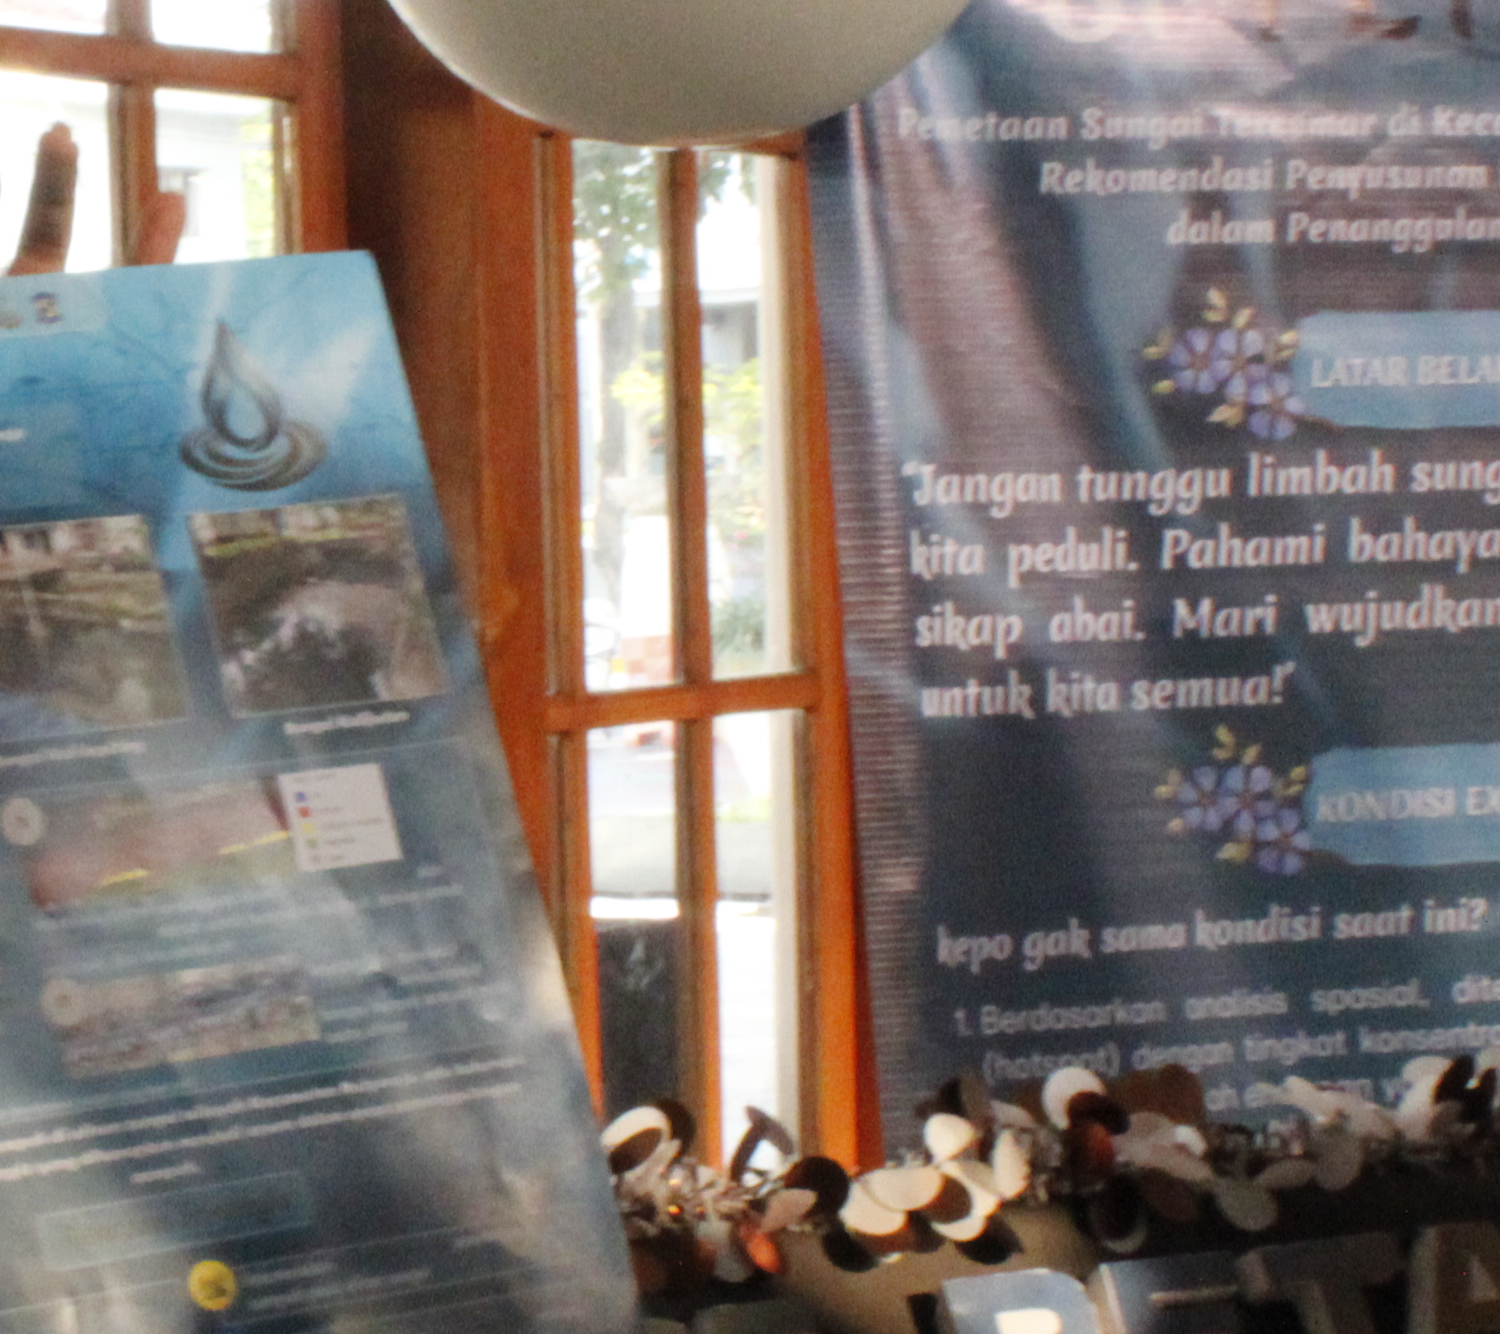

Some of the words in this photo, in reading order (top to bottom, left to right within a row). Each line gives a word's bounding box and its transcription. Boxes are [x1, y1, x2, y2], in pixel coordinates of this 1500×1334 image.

[1080, 107, 1203, 149] Sungai
[1386, 102, 1420, 137] di
[1038, 157, 1275, 197] Rekomendasi
[1284, 157, 1492, 200] Penyusunan
[1166, 215, 1277, 247] dalam
[1310, 354, 1410, 389] LATAR
[1077, 465, 1234, 514] tunggu
[1247, 450, 1395, 499] limbah
[910, 535, 985, 577] kita
[1007, 530, 1139, 587] peduli.
[1162, 525, 1326, 572] Pahami
[914, 606, 1023, 658] sikap
[1049, 601, 1147, 645] abai.
[1172, 600, 1277, 639] Mari
[920, 675, 1035, 720] untuk
[1047, 673, 1121, 718] kita
[1315, 785, 1456, 822] KONDISI
[936, 925, 1013, 973] kepo
[1022, 917, 1093, 970] gak
[1100, 921, 1188, 953] sama
[1194, 905, 1322, 950] kondisi
[1333, 904, 1412, 939] saat
[1422, 898, 1488, 933] ini?
[981, 999, 1167, 1035] Berdasarkan
[1243, 1027, 1348, 1065] tingkat
